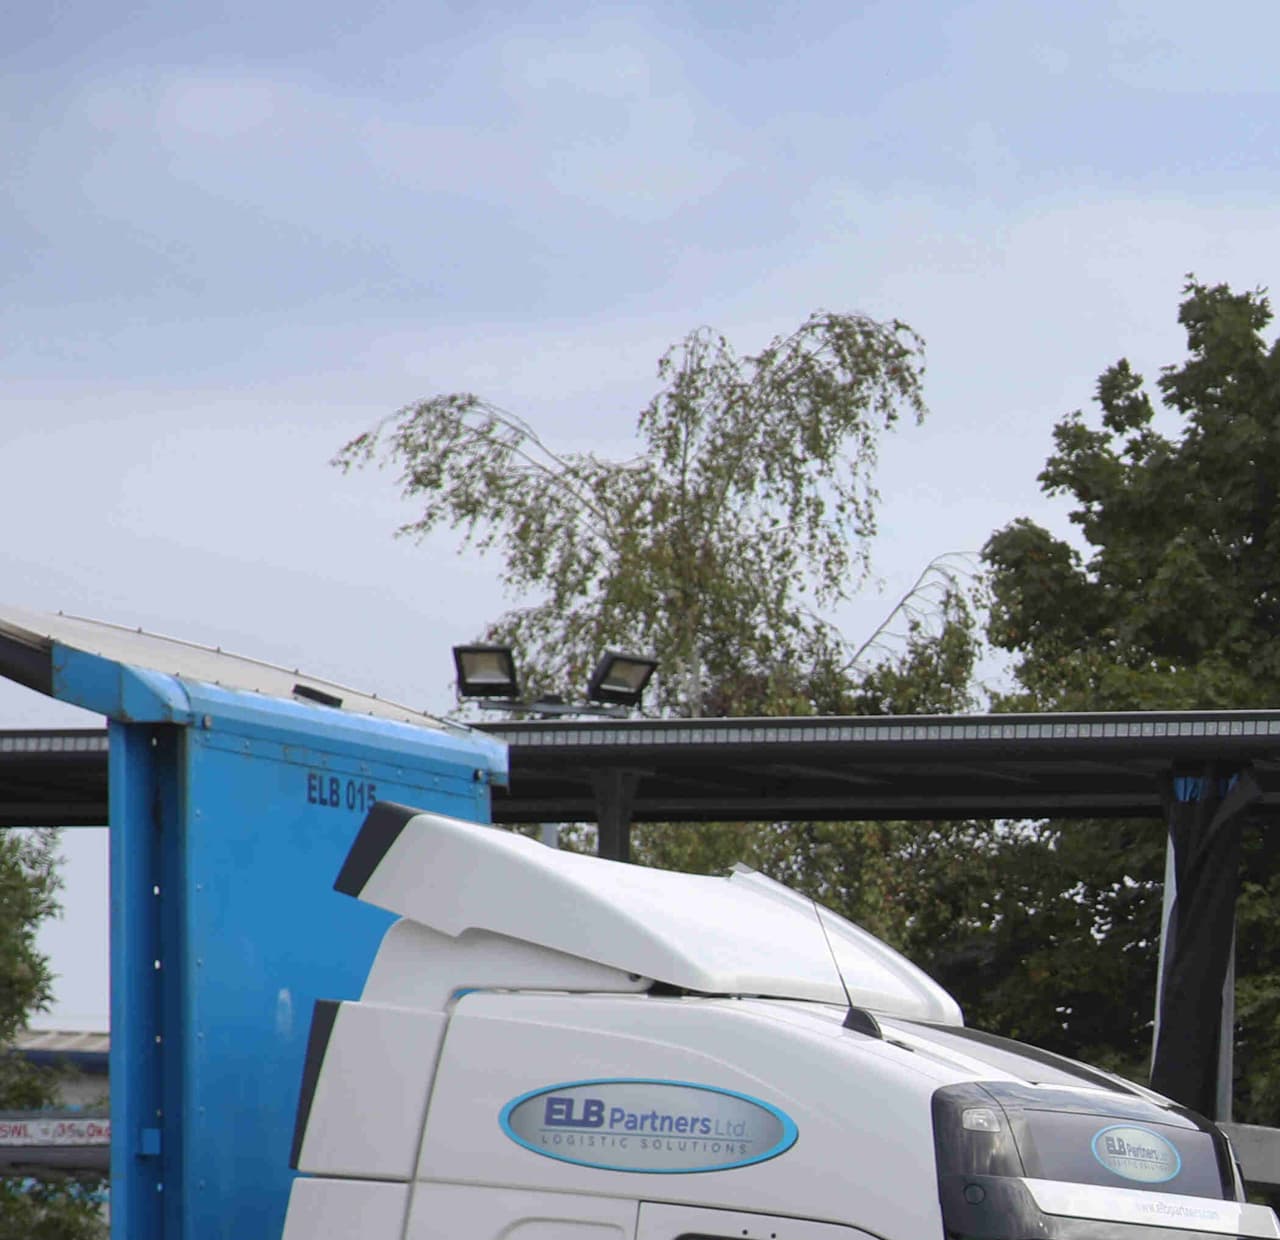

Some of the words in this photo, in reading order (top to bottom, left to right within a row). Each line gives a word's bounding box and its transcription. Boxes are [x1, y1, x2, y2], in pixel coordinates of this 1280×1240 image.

[307, 773, 340, 808] ELB
[346, 779, 377, 814] 015
[544, 1097, 605, 1128] ELB
[609, 1107, 712, 1134] Partners
[714, 1119, 749, 1138] Ltd.
[541, 1135, 628, 1149] LOGISTIC
[640, 1138, 748, 1155] SOLUTIONS
